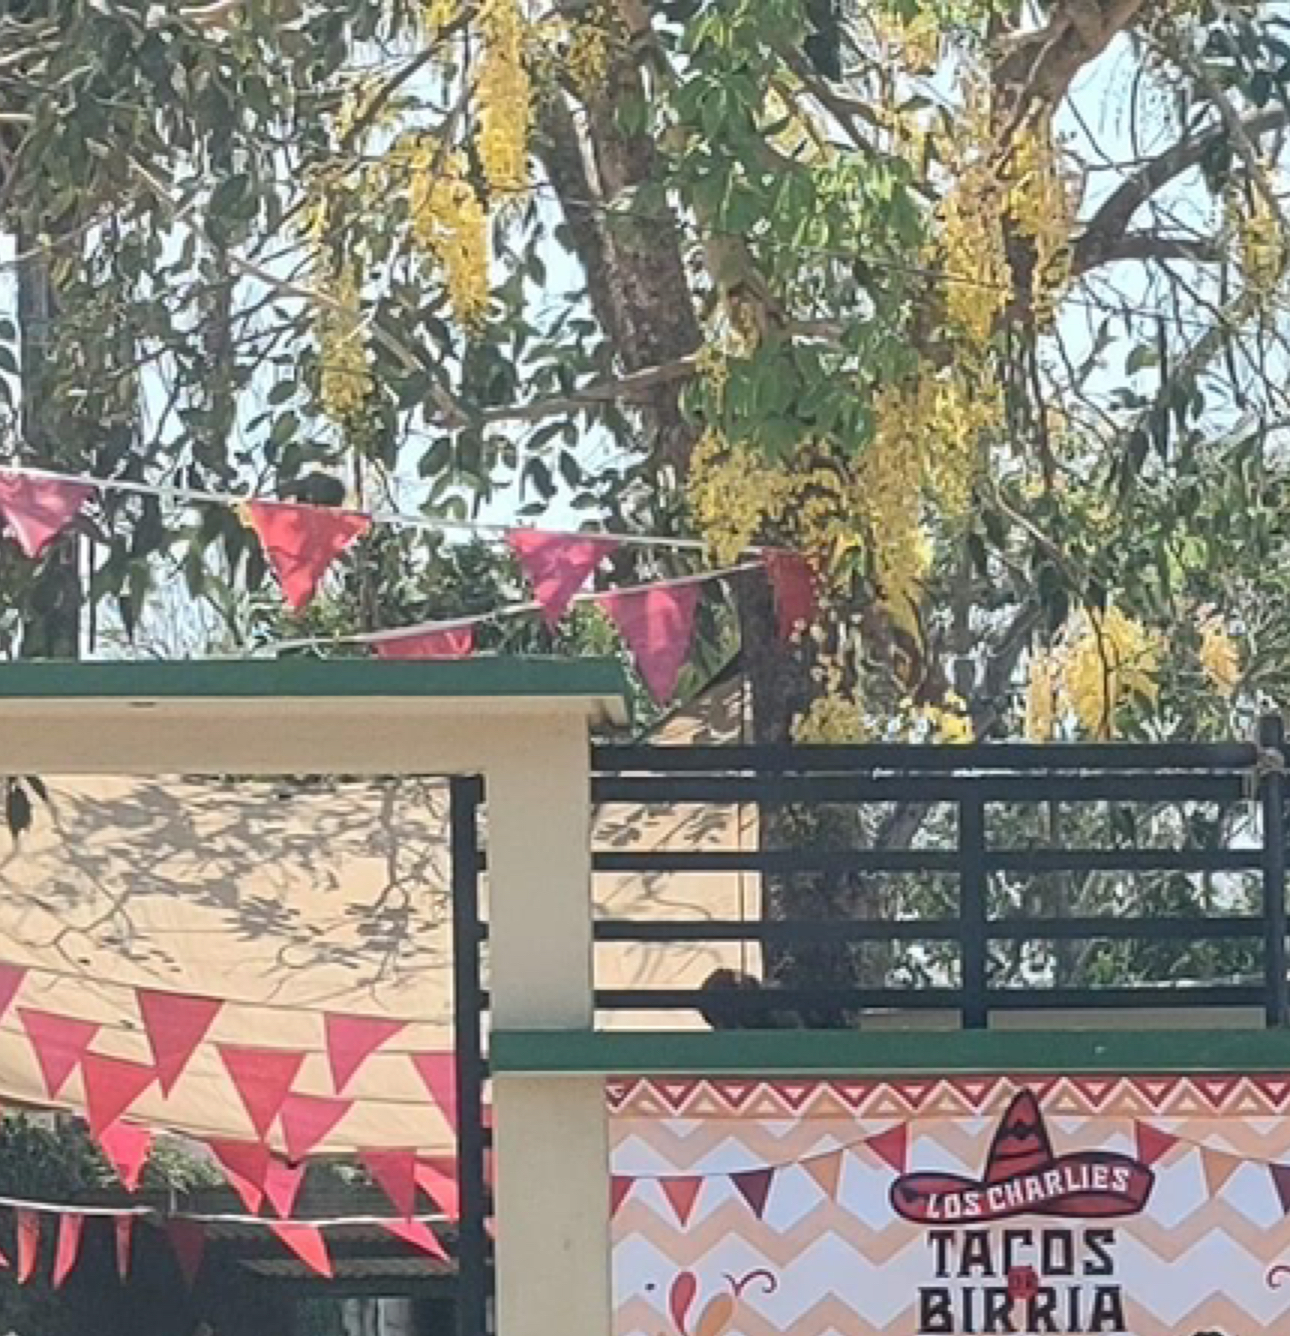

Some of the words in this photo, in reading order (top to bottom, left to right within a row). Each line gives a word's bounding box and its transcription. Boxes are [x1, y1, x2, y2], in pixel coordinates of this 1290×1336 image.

[925, 1192, 982, 1219] LOS
[986, 1164, 1131, 1211] CHARLIES
[929, 1229, 1116, 1278] TACOS
[917, 1285, 1126, 1334] BIRRIA
